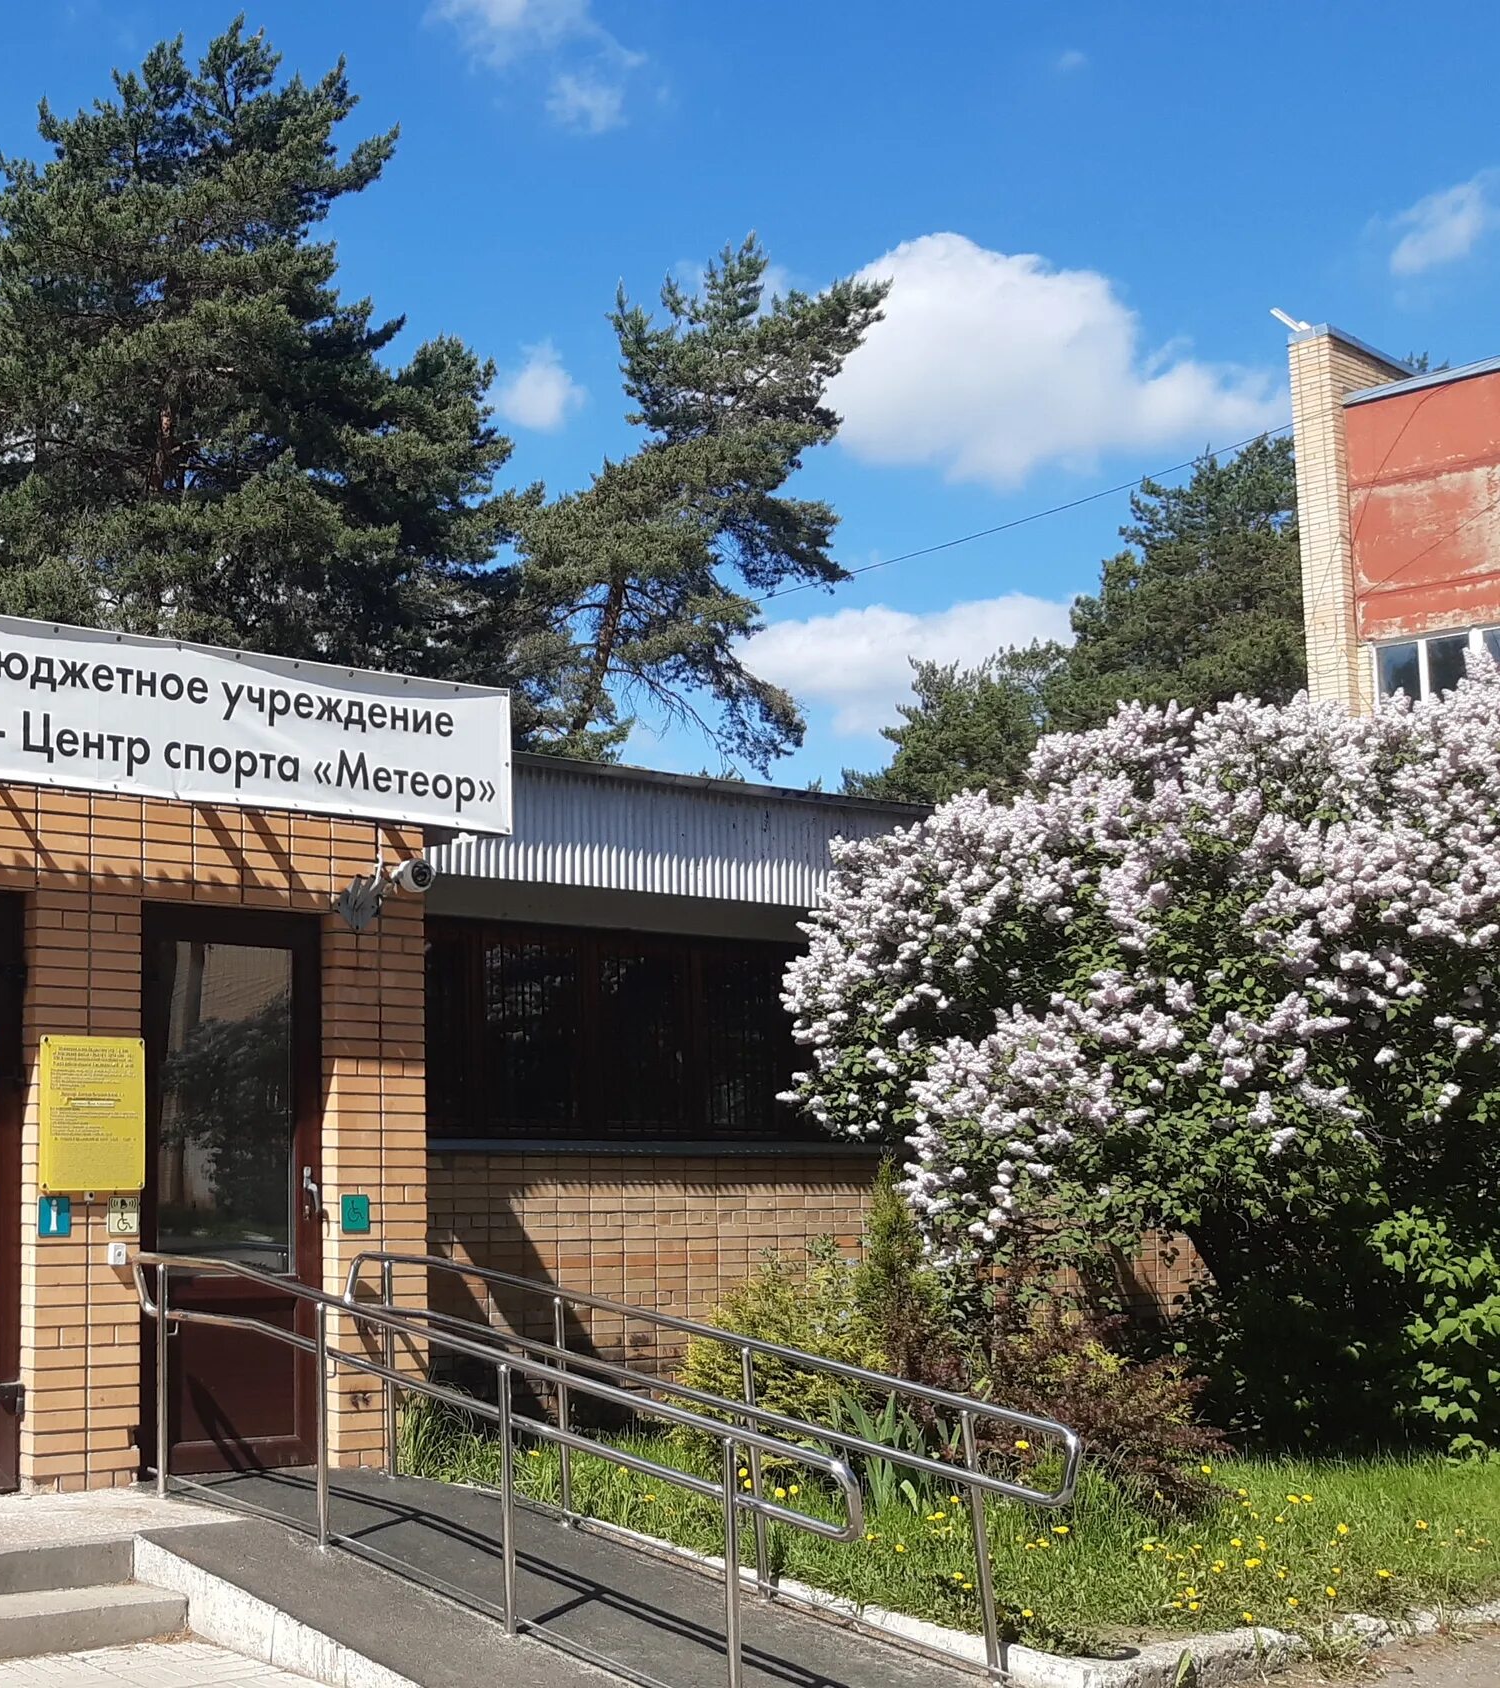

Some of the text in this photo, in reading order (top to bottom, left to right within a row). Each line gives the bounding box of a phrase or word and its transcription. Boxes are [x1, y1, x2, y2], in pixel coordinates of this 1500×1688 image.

[222, 681, 454, 738] учреждение
[23, 711, 150, 776] Центр
[164, 741, 299, 788] спорта
[314, 750, 496, 811] «Метеор»
